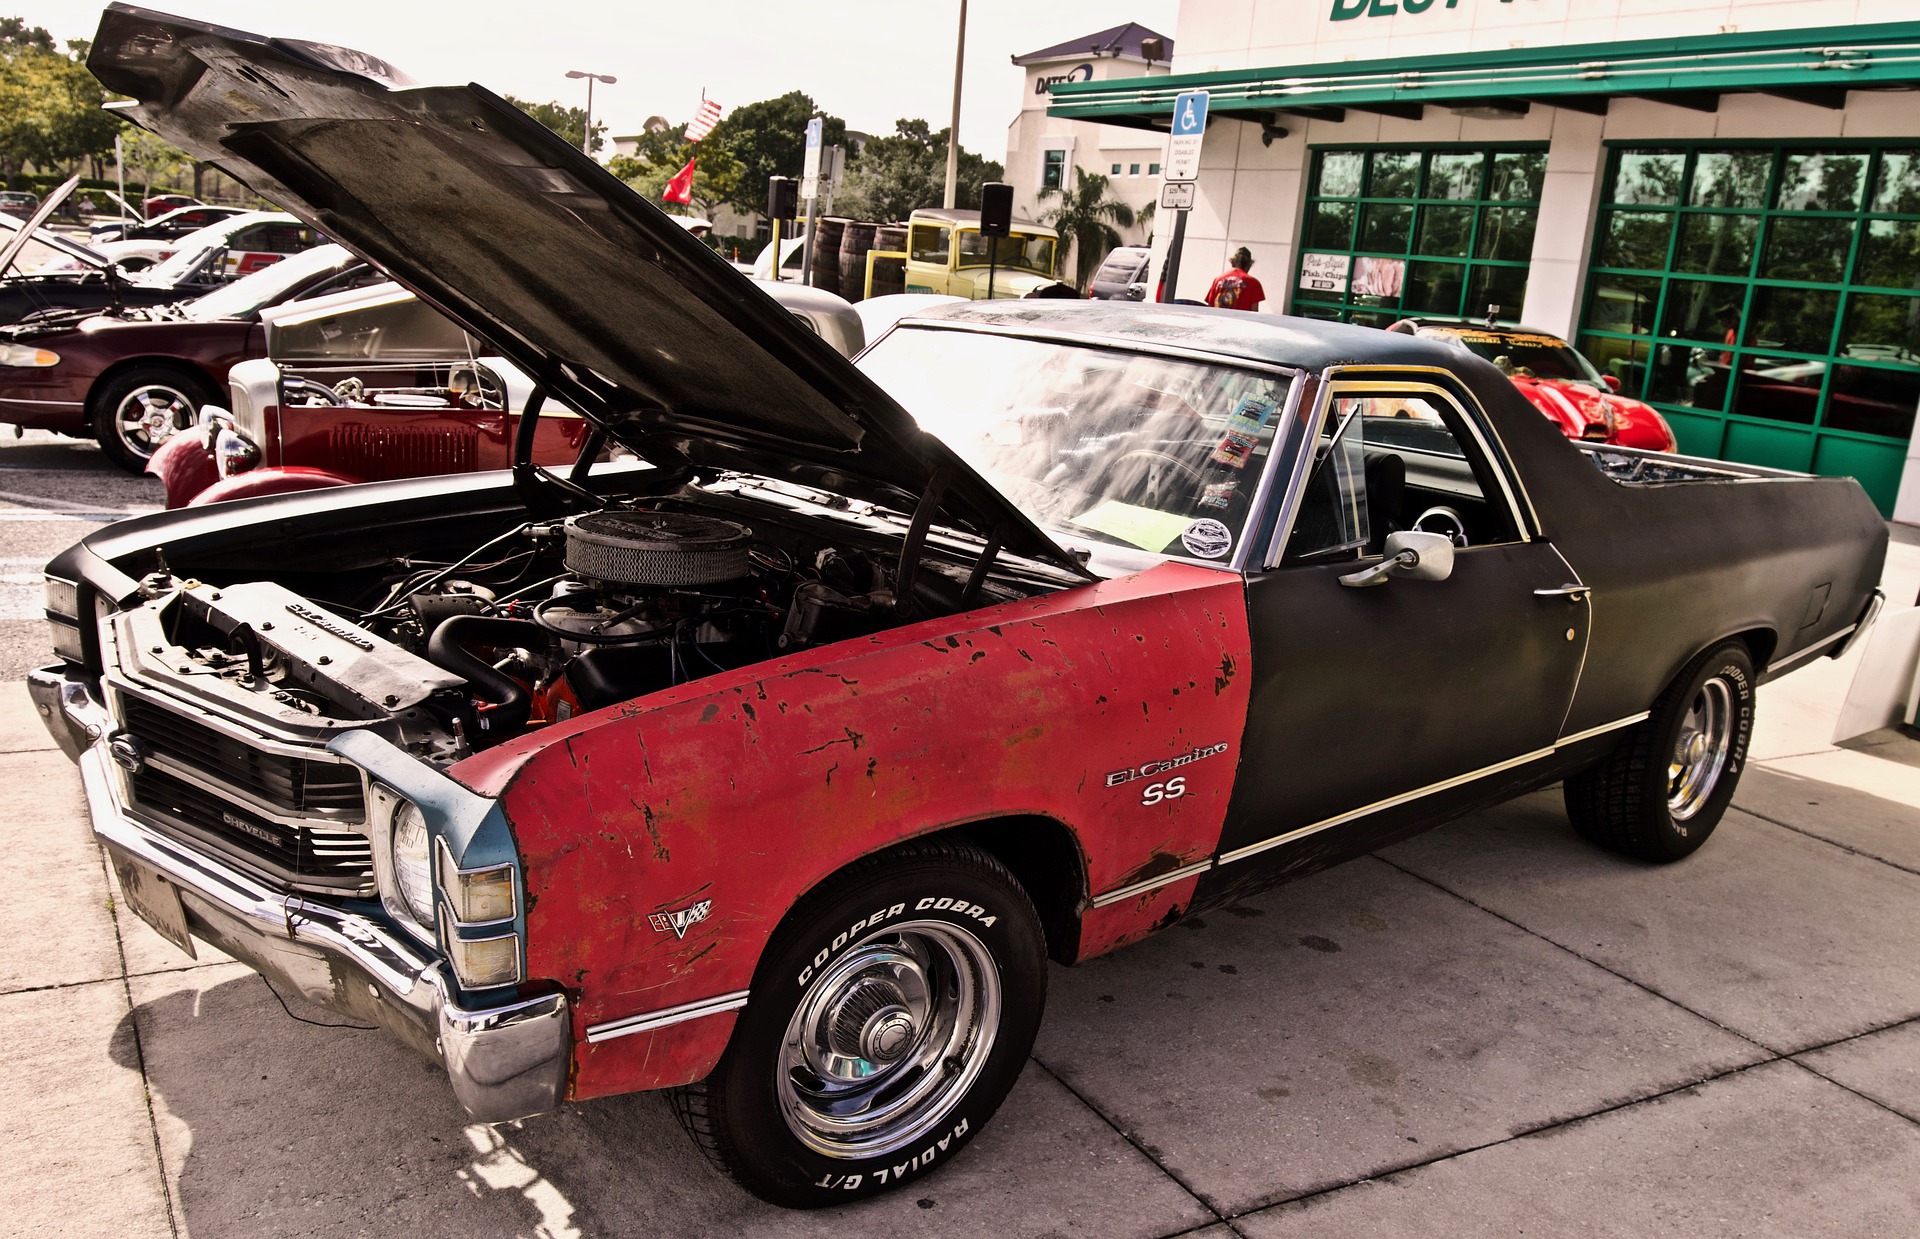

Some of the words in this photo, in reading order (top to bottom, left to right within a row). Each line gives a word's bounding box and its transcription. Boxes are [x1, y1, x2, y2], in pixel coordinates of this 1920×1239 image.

[1302, 269, 1320, 278] Fish
[1325, 271, 1348, 281] Chips
[1720, 665, 1749, 700] COOPER
[1729, 706, 1750, 773] COBRA
[1139, 741, 1228, 779] Camino
[1141, 776, 1187, 806] SS
[222, 811, 283, 847] CHEVELLE
[797, 902, 906, 987] COOPER
[914, 897, 999, 928] COBRA
[873, 1117, 970, 1185] RADIAL
[814, 1173, 863, 1191] G/T
